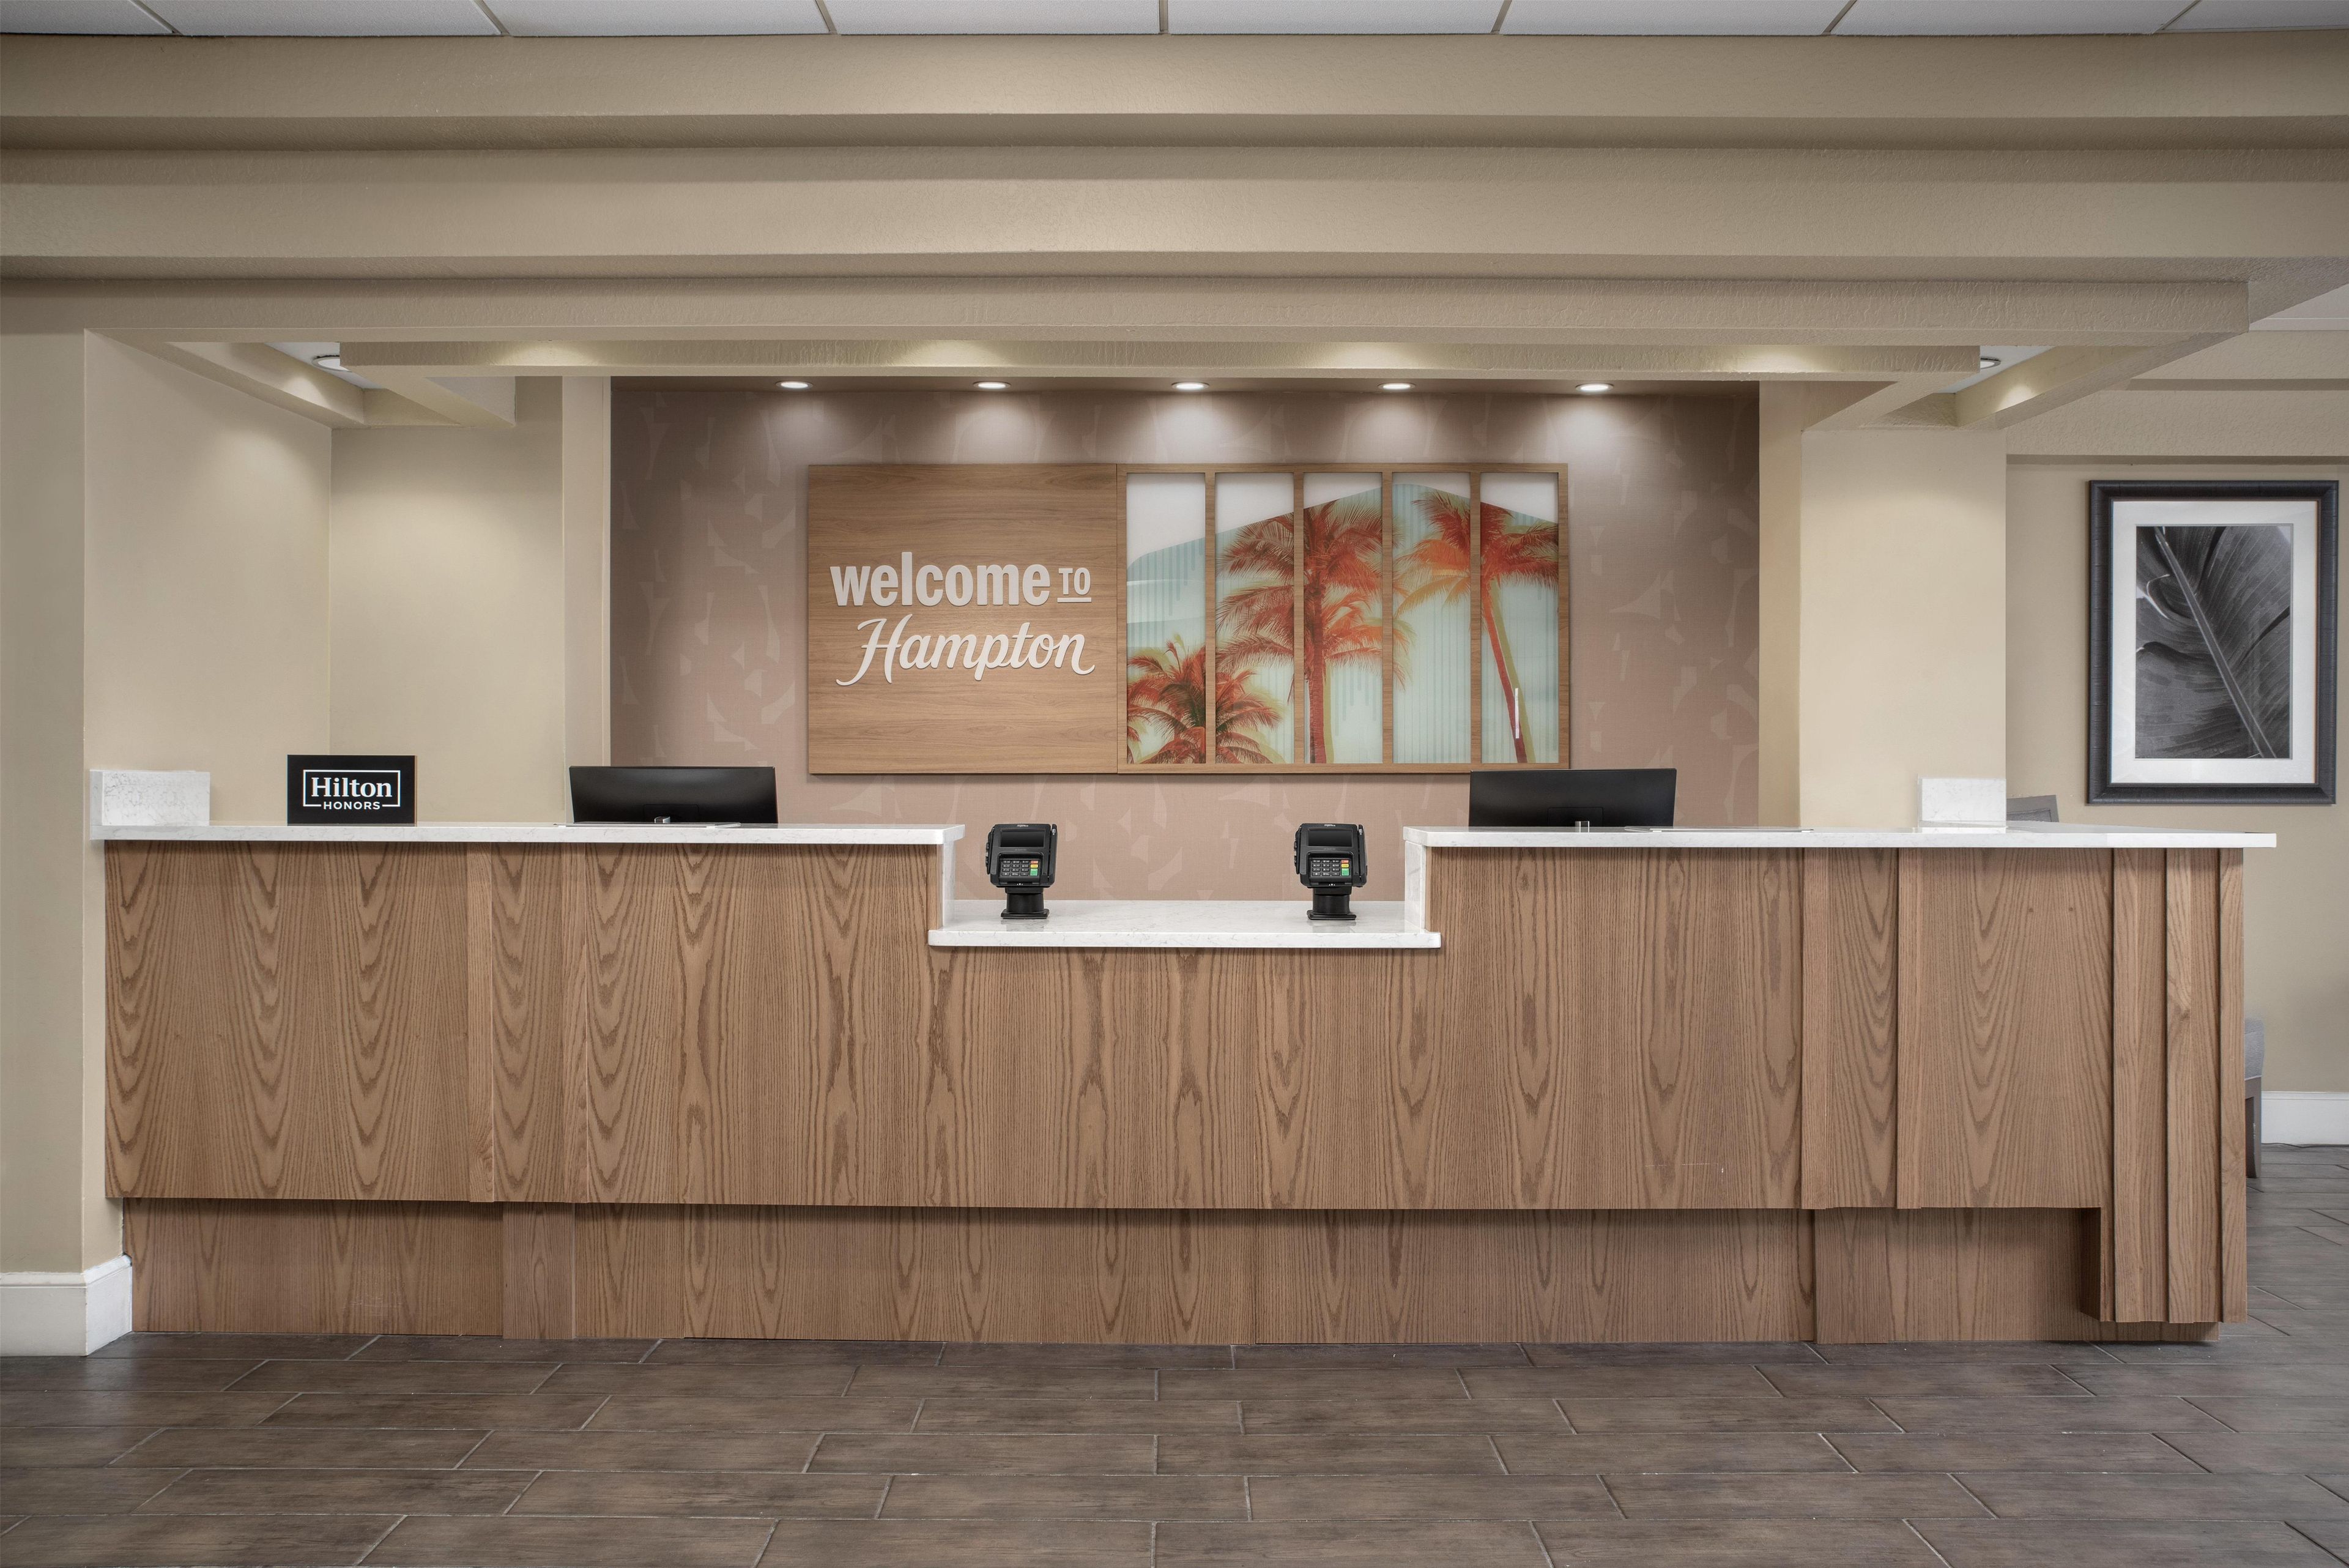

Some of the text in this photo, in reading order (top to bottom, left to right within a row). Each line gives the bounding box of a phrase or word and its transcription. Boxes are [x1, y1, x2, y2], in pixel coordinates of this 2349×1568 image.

[829, 552, 1091, 606] welcome TO
[836, 614, 1096, 686] Hampton
[311, 777, 393, 798] Hilton
[323, 801, 380, 810] HONORS
